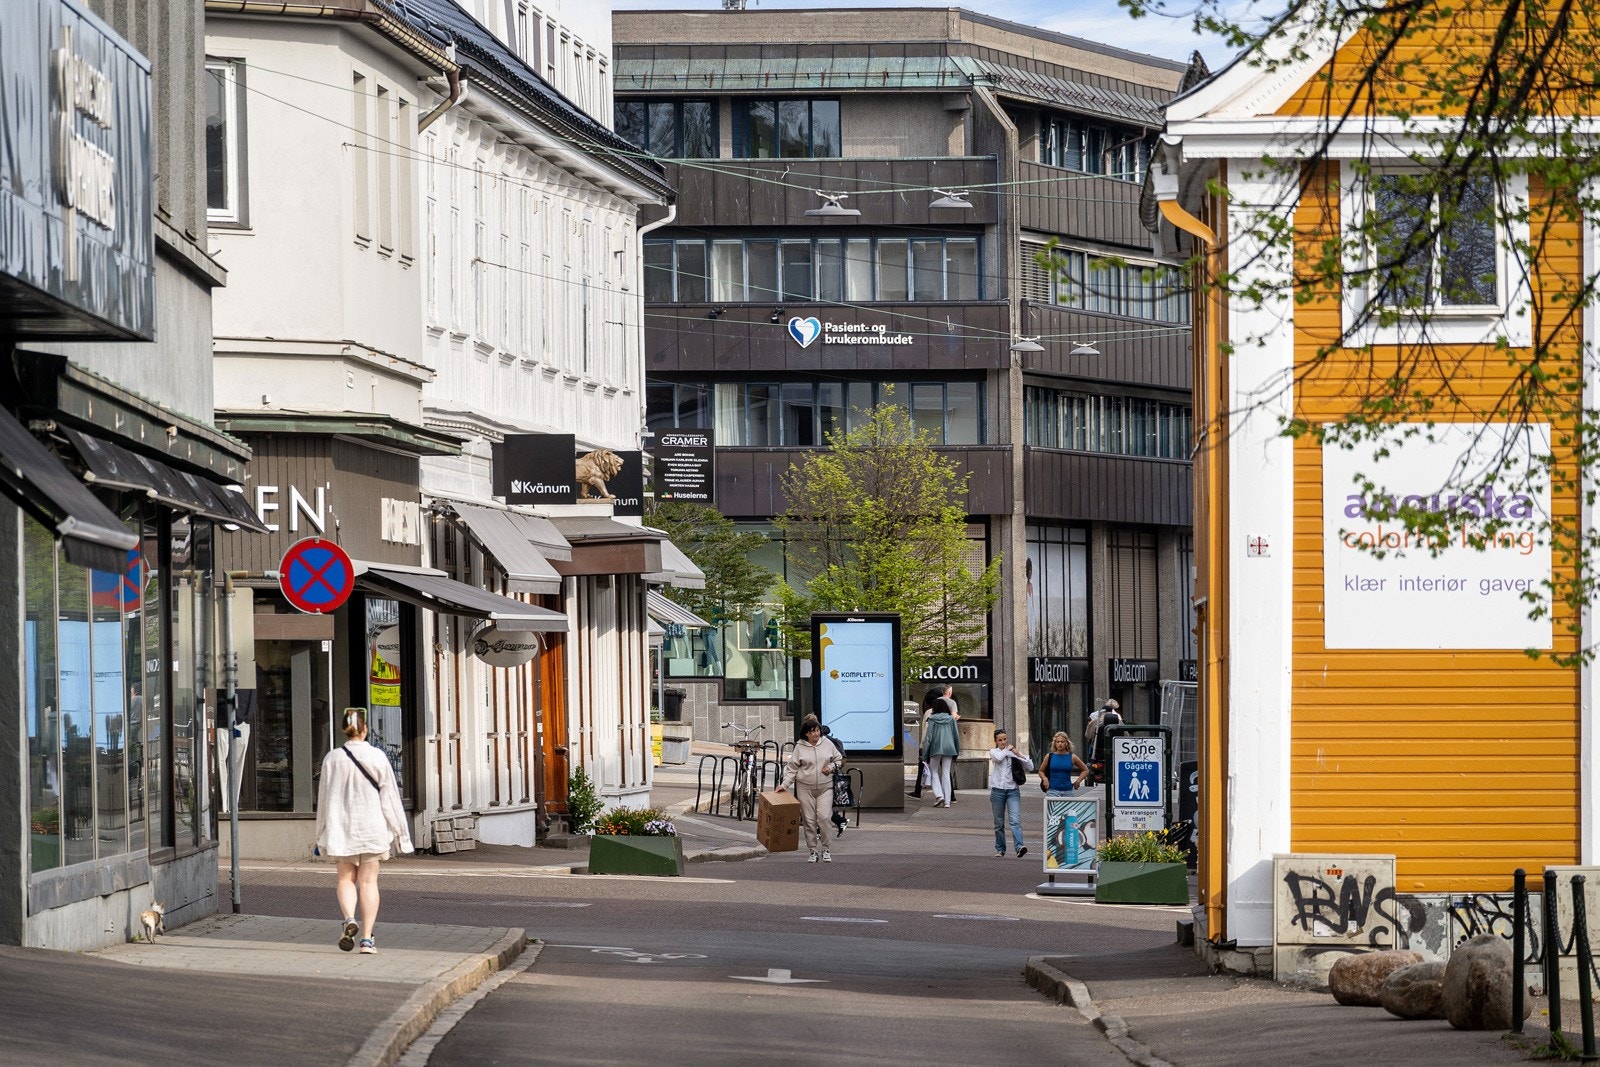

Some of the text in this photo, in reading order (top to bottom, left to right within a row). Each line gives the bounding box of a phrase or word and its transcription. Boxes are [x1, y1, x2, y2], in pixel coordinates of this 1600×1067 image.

[825, 322, 886, 334] Pasient- og
[825, 335, 913, 344] brukerombudet
[661, 437, 708, 445] CRAMER
[523, 481, 570, 493] Kvänum
[1344, 575, 1534, 595] klær interiør gaver
[1034, 658, 1069, 682] Bolia.com
[1114, 658, 1146, 682] Bolia.com
[1121, 742, 1156, 754] Sone
[1124, 762, 1153, 772] Gågate
